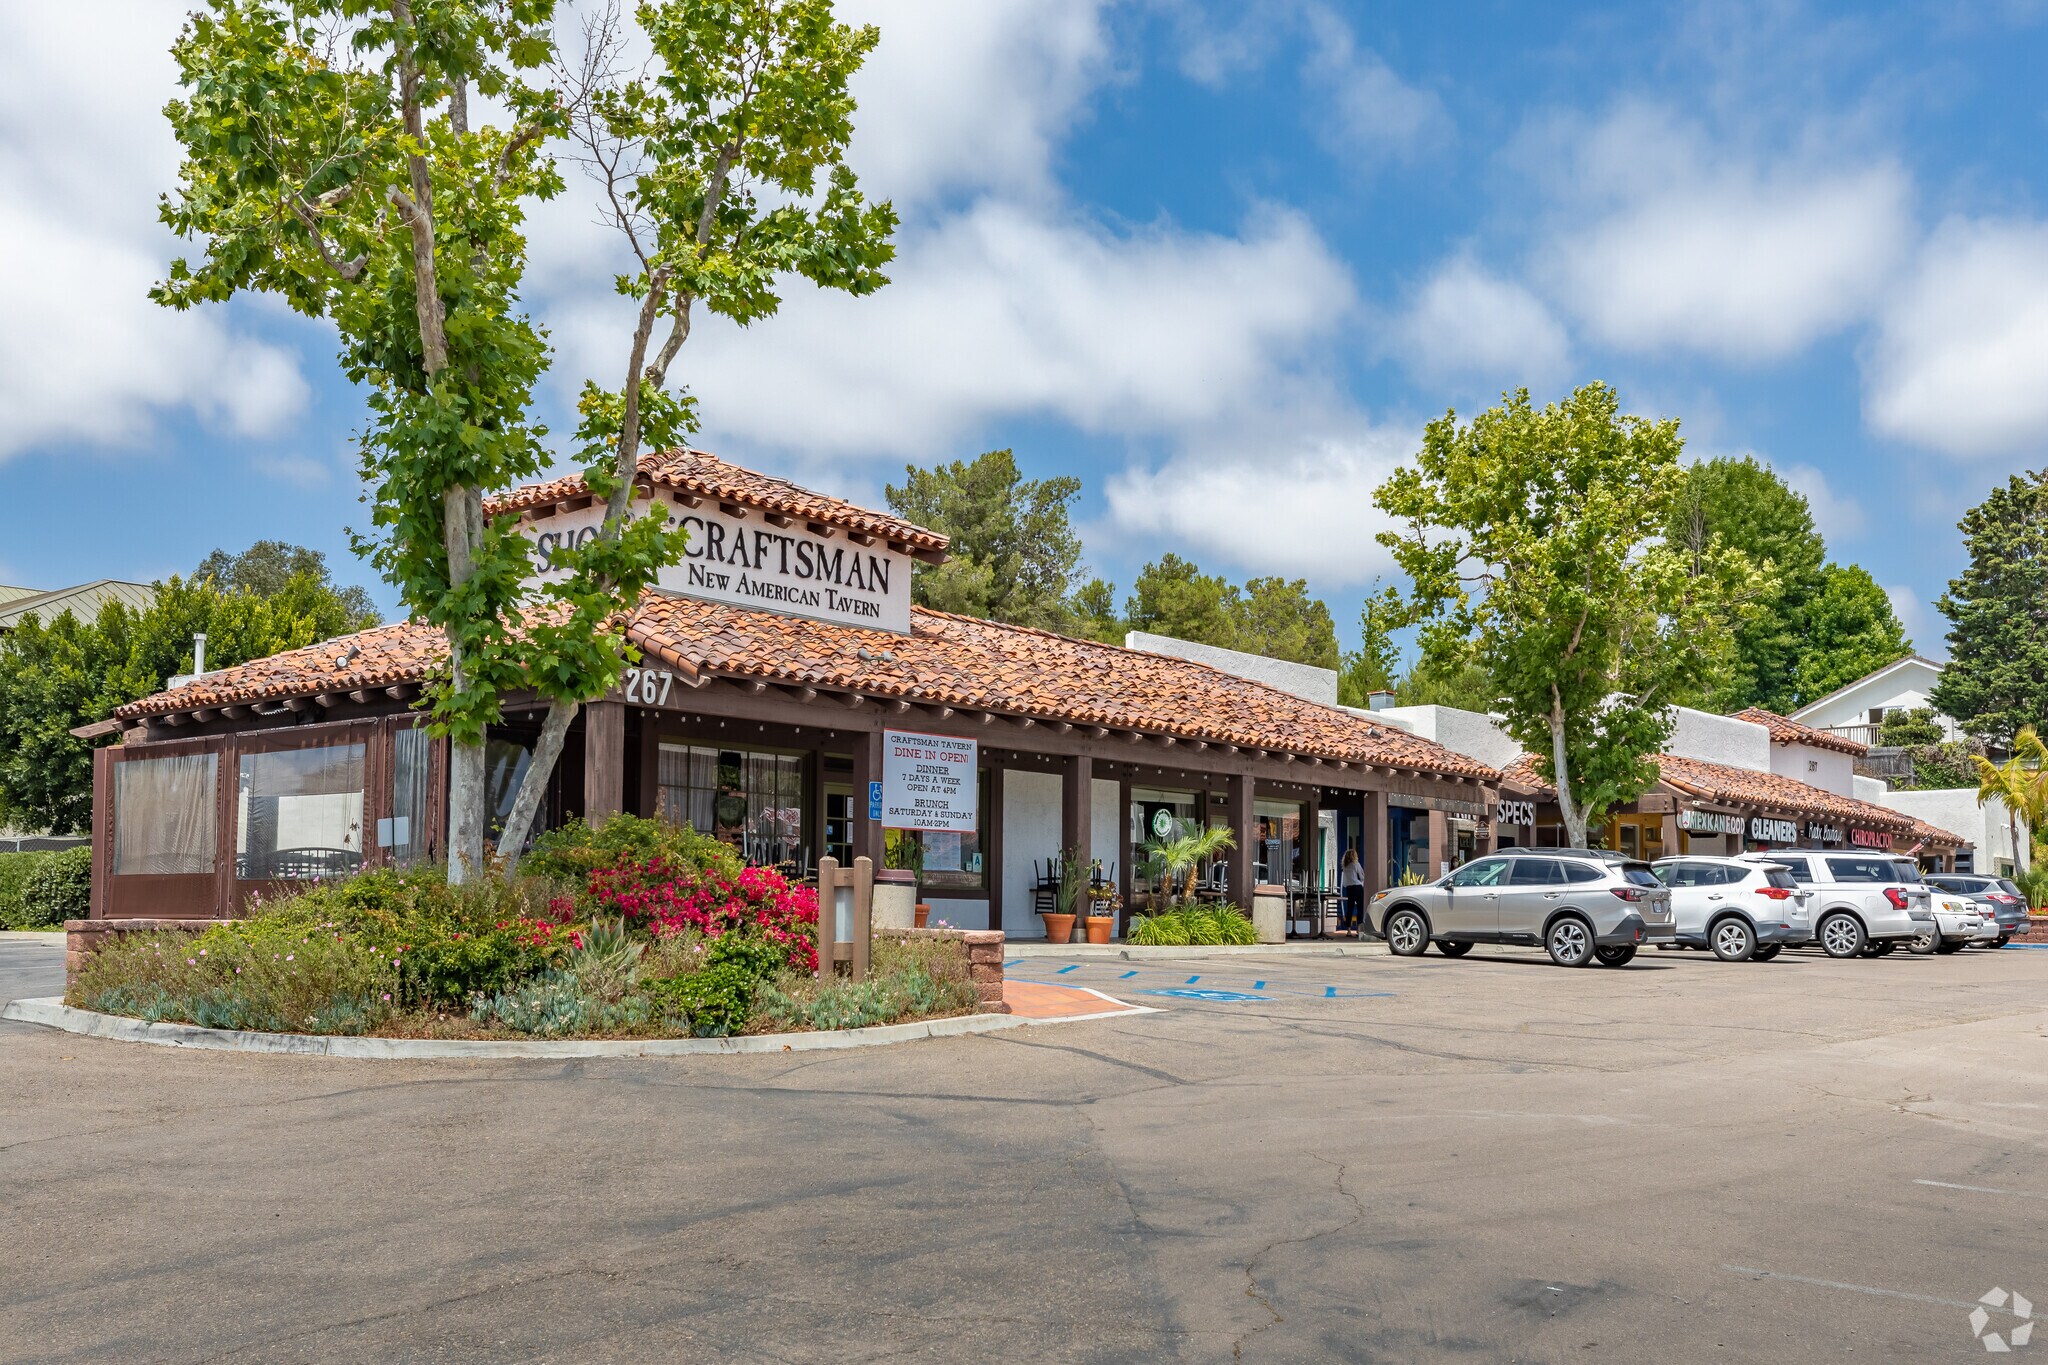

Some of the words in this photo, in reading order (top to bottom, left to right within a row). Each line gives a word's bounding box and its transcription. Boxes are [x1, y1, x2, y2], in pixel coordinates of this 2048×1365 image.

[678, 516, 891, 594] CRAFTSMAN
[688, 563, 730, 591] NEW
[735, 572, 820, 607] AMERICAN
[825, 588, 880, 618] TAVERN
[626, 668, 673, 706] 267
[891, 736, 939, 747] CRAFTSMAN
[941, 741, 972, 750] TAVERN
[894, 747, 921, 759] DINE
[925, 750, 936, 760] IN
[940, 752, 968, 763] OPEN!
[916, 764, 949, 775] DINNER
[908, 774, 930, 782] DAYS
[941, 777, 961, 785] WEEK
[907, 783, 928, 792] OPEN
[930, 785, 941, 793] AT
[914, 798, 949, 809] BRUNCH
[889, 807, 933, 817] SATURDAY
[940, 811, 973, 819] SUNDAY
[1497, 800, 1534, 826] SPECS
[914, 819, 950, 828] 10AM-2PM
[1690, 811, 1725, 832] MEXICAN
[1725, 815, 1745, 835] FOOD
[1751, 817, 1797, 843] CLEANERS
[1851, 828, 1893, 848] CHIROPRACTOR
[975, 855, 981, 866] A
